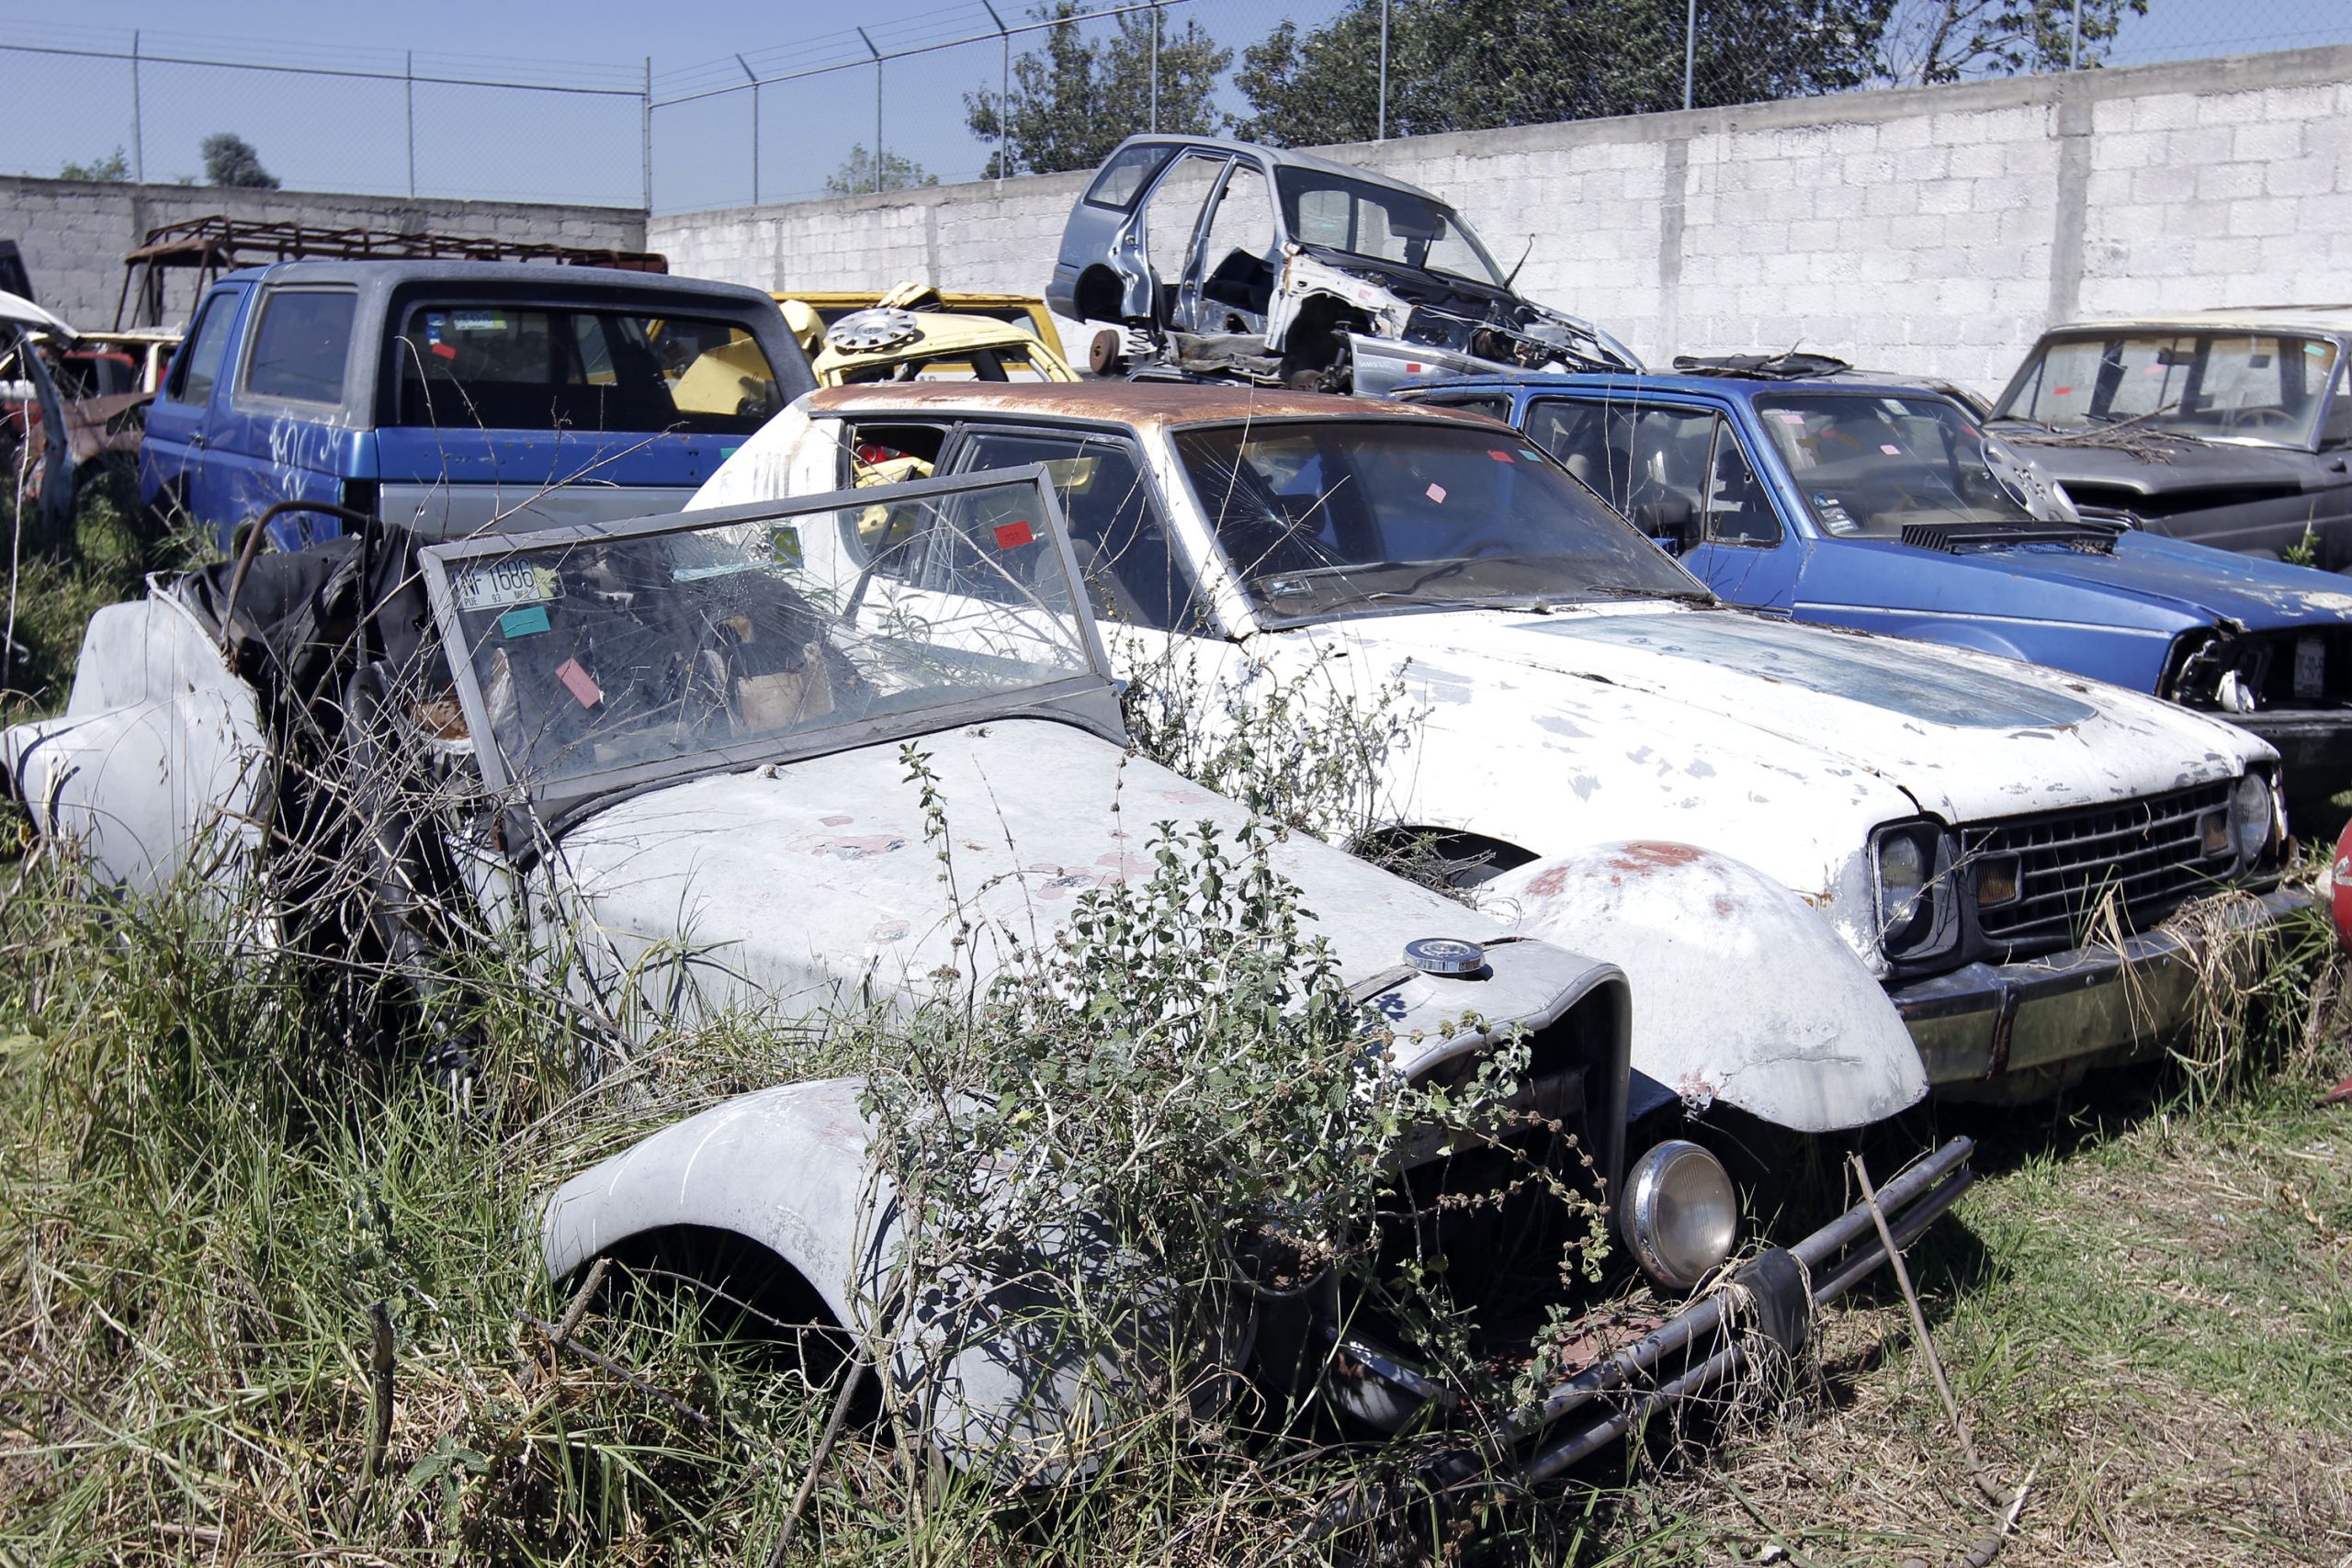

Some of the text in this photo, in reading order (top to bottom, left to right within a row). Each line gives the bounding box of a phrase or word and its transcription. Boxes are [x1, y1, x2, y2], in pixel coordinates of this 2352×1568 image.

[489, 558, 535, 593] 1686
[463, 596, 479, 607] PUE
[492, 592, 502, 604] 93
